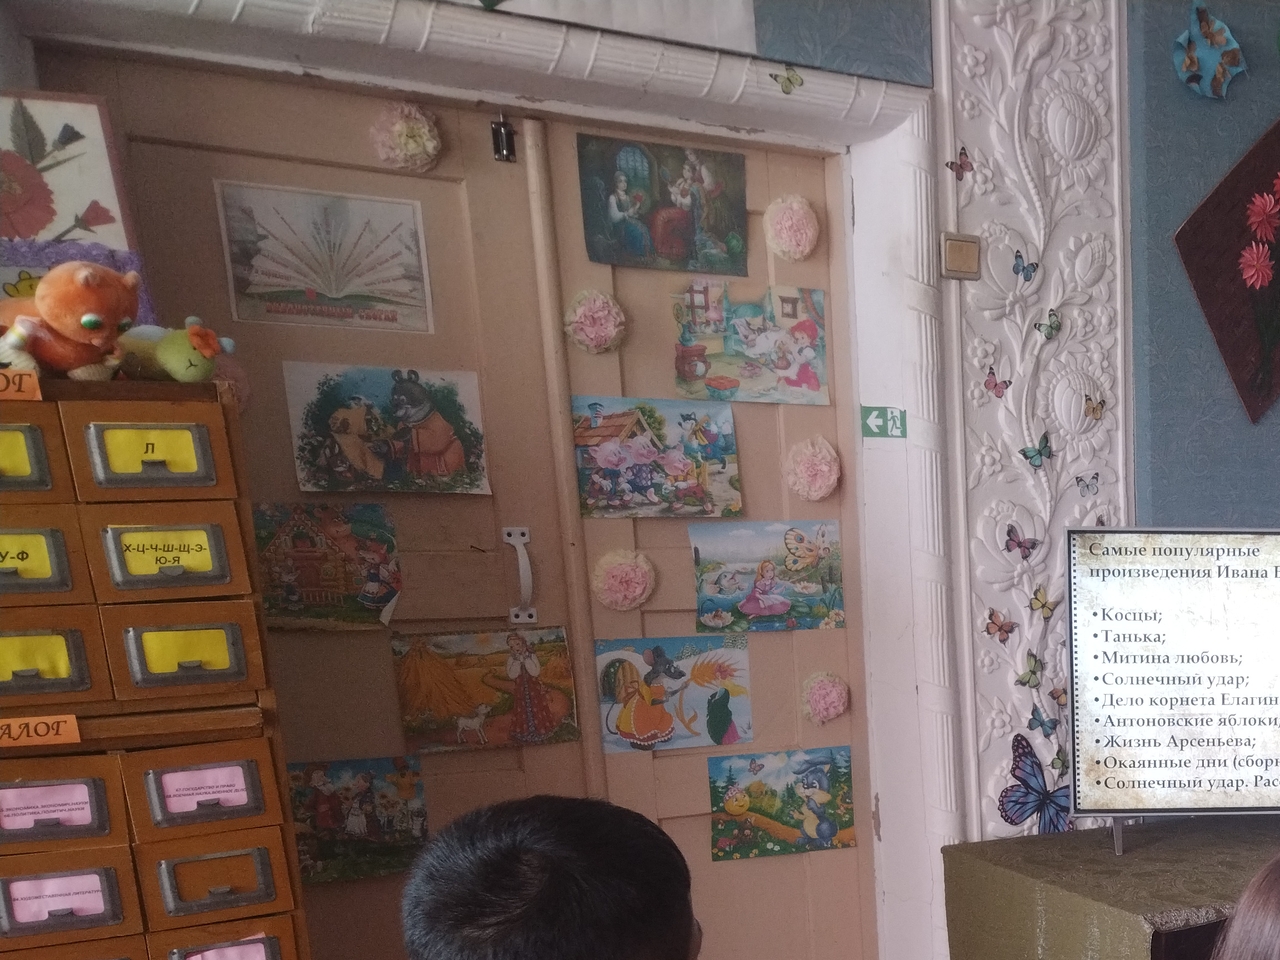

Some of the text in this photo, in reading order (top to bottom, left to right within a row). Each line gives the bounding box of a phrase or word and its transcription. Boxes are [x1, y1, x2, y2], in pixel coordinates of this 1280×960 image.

[1089, 542, 1260, 561] Самые популярные
[155, 556, 181, 565] Ю-Я
[1089, 567, 1212, 582] произведения
[1217, 566, 1268, 579] Ивана
[1101, 608, 1163, 623] Косцы;
[1101, 629, 1166, 644] Танька;
[1102, 651, 1243, 666] Митина любовь;
[1103, 672, 1250, 688] Солнечный удар;
[1102, 694, 1144, 709] Дело
[1149, 696, 1215, 710] корнета
[1103, 714, 1214, 727] Антоновские
[0, 720, 67, 741] АЛОГ
[1104, 735, 1256, 751] Жизнь Арсеньева;
[1104, 756, 1191, 769] Окаянные
[1196, 758, 1227, 770] дни
[1104, 776, 1202, 790] Солнечный
[1206, 779, 1248, 792] удар.
